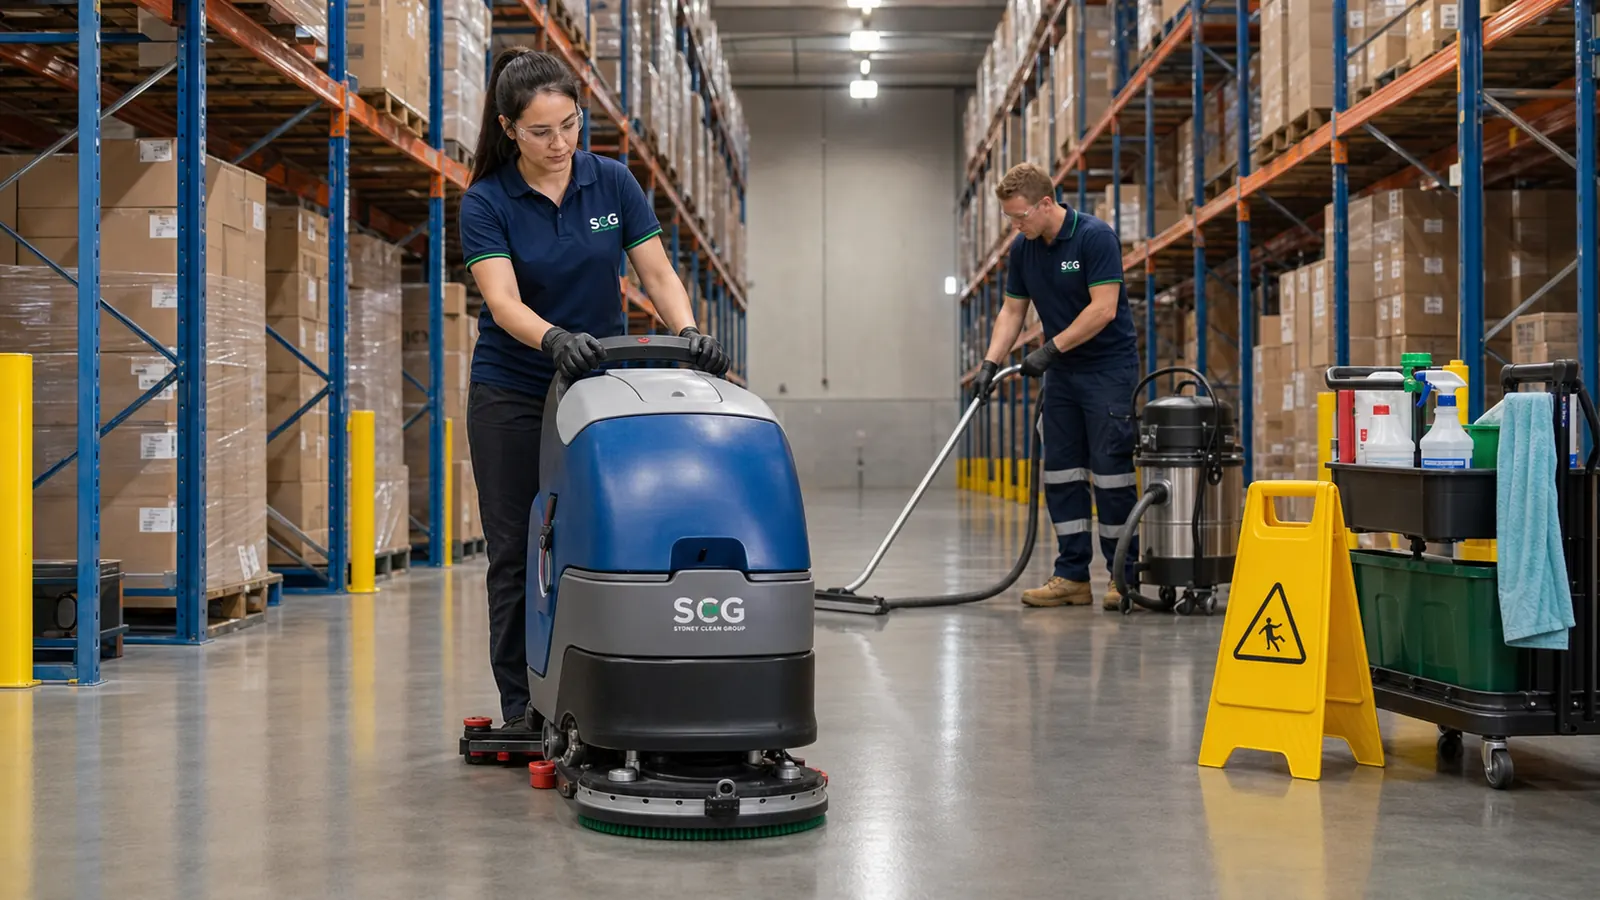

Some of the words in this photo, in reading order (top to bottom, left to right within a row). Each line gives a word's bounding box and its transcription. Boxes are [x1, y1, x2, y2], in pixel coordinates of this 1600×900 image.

[589, 213, 619, 230] SCG
[1061, 260, 1080, 270] SCG
[673, 597, 745, 624] SCG
